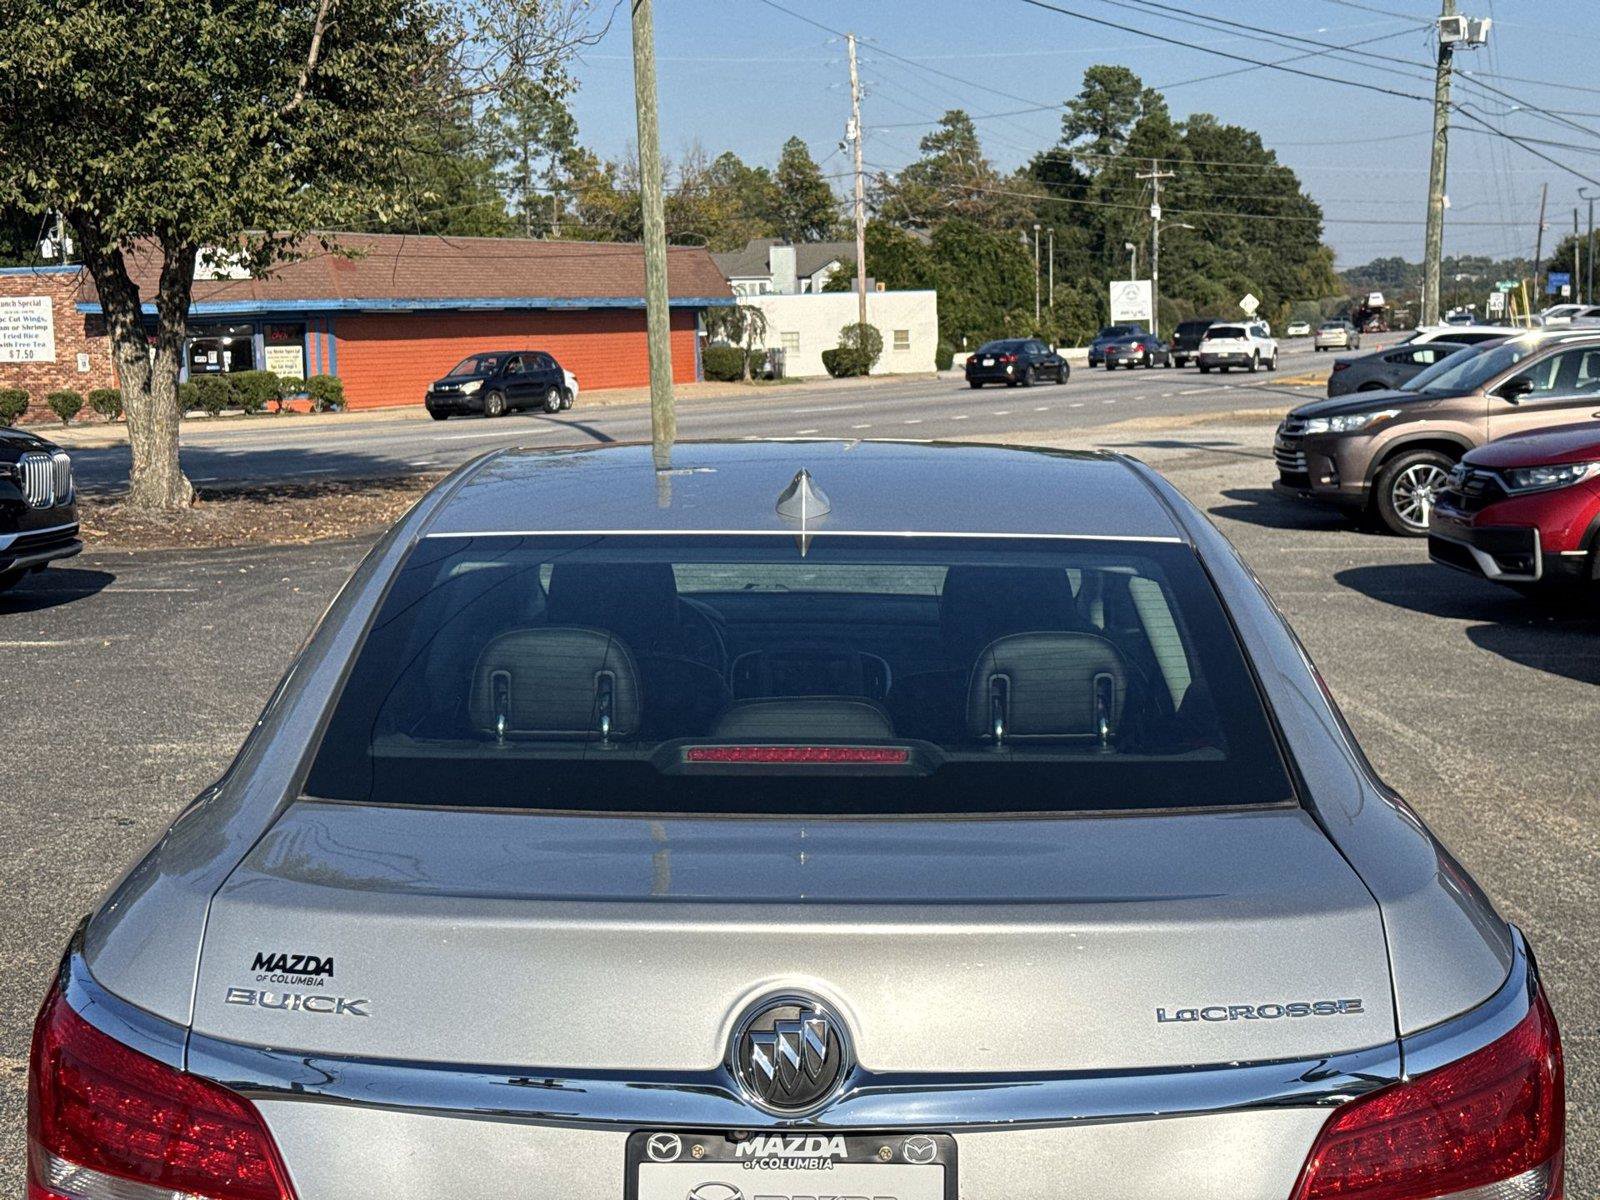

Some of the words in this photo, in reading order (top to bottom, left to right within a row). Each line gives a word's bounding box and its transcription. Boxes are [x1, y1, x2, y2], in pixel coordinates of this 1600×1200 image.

[0, 300, 16, 308] unch
[18, 299, 41, 308] Special
[250, 951, 335, 978] MAZDA
[255, 974, 268, 982] OF
[269, 973, 325, 987] COLUMBIA
[224, 987, 373, 1018] BUICK
[734, 1133, 849, 1159] MAZDA
[744, 1159, 757, 1170] of
[758, 1157, 834, 1170] COLUMBIA
